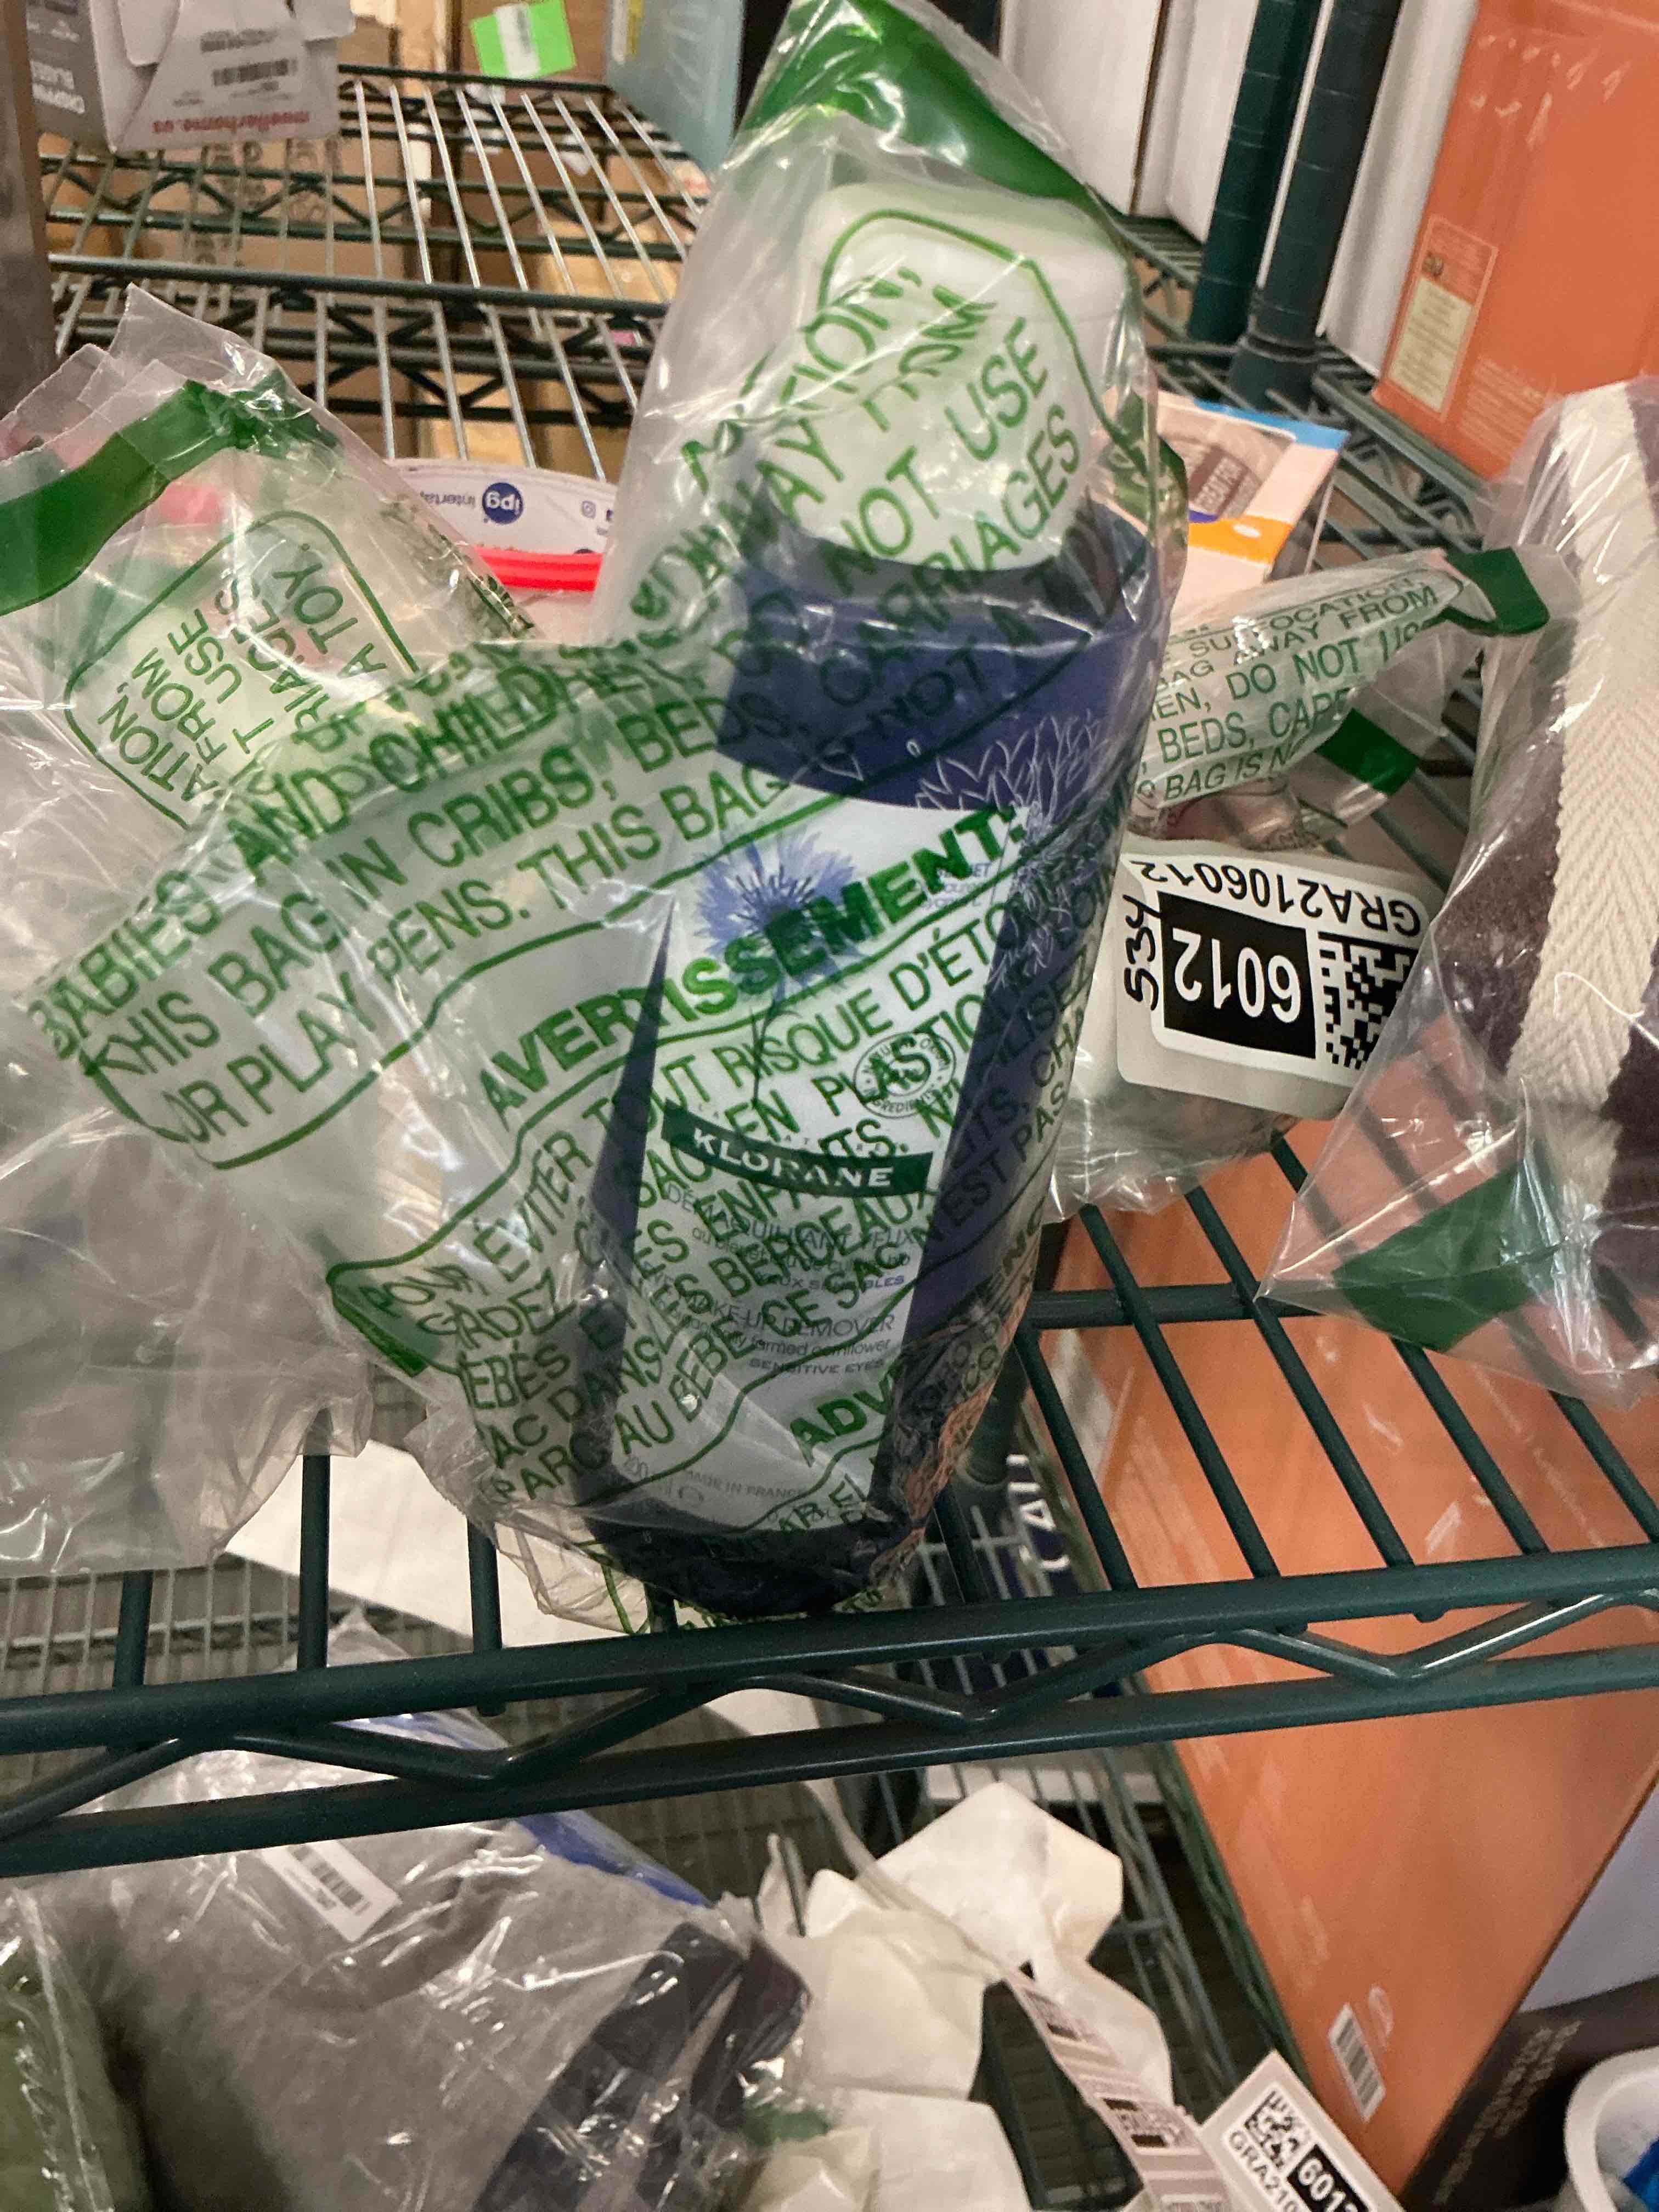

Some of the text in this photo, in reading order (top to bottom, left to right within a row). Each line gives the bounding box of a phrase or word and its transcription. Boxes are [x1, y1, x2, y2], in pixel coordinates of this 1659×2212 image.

[819, 445, 941, 597] NOT
[945, 315, 1049, 462] USE
[166, 608, 243, 704] USE
[272, 543, 387, 678] A TOY.
[1339, 584, 1439, 631] FROM
[131, 646, 228, 766] FROM
[1224, 662, 1277, 701] DO
[1291, 636, 1361, 687] NOT
[1156, 711, 1255, 765] BEDS,
[1163, 763, 1227, 802] BAG
[1234, 753, 1262, 781] IS
[207, 893, 349, 1018] BAG
[325, 836, 410, 912] IN
[407, 743, 618, 868] CRIBS,
[1129, 860, 1422, 939] GRA2106012
[226, 972, 380, 1115] PLAY
[366, 878, 531, 983] PENS.
[516, 804, 661, 909] THIS
[659, 764, 793, 841] BAG
[479, 803, 1027, 1131] AVERTISSEMENT:
[1122, 893, 1161, 1012] 534
[1171, 927, 1302, 1024] 6012
[471, 1130, 594, 1284] ÉVITER
[711, 989, 894, 1090] RISQUE
[692, 1127, 896, 1188] KLORANE
[724, 1091, 802, 1143] EN
[613, 1398, 675, 1455] AU
[760, 1288, 835, 1338] CE
[824, 1240, 911, 1311] SAC
[1010, 1080, 1070, 1162] PAS
